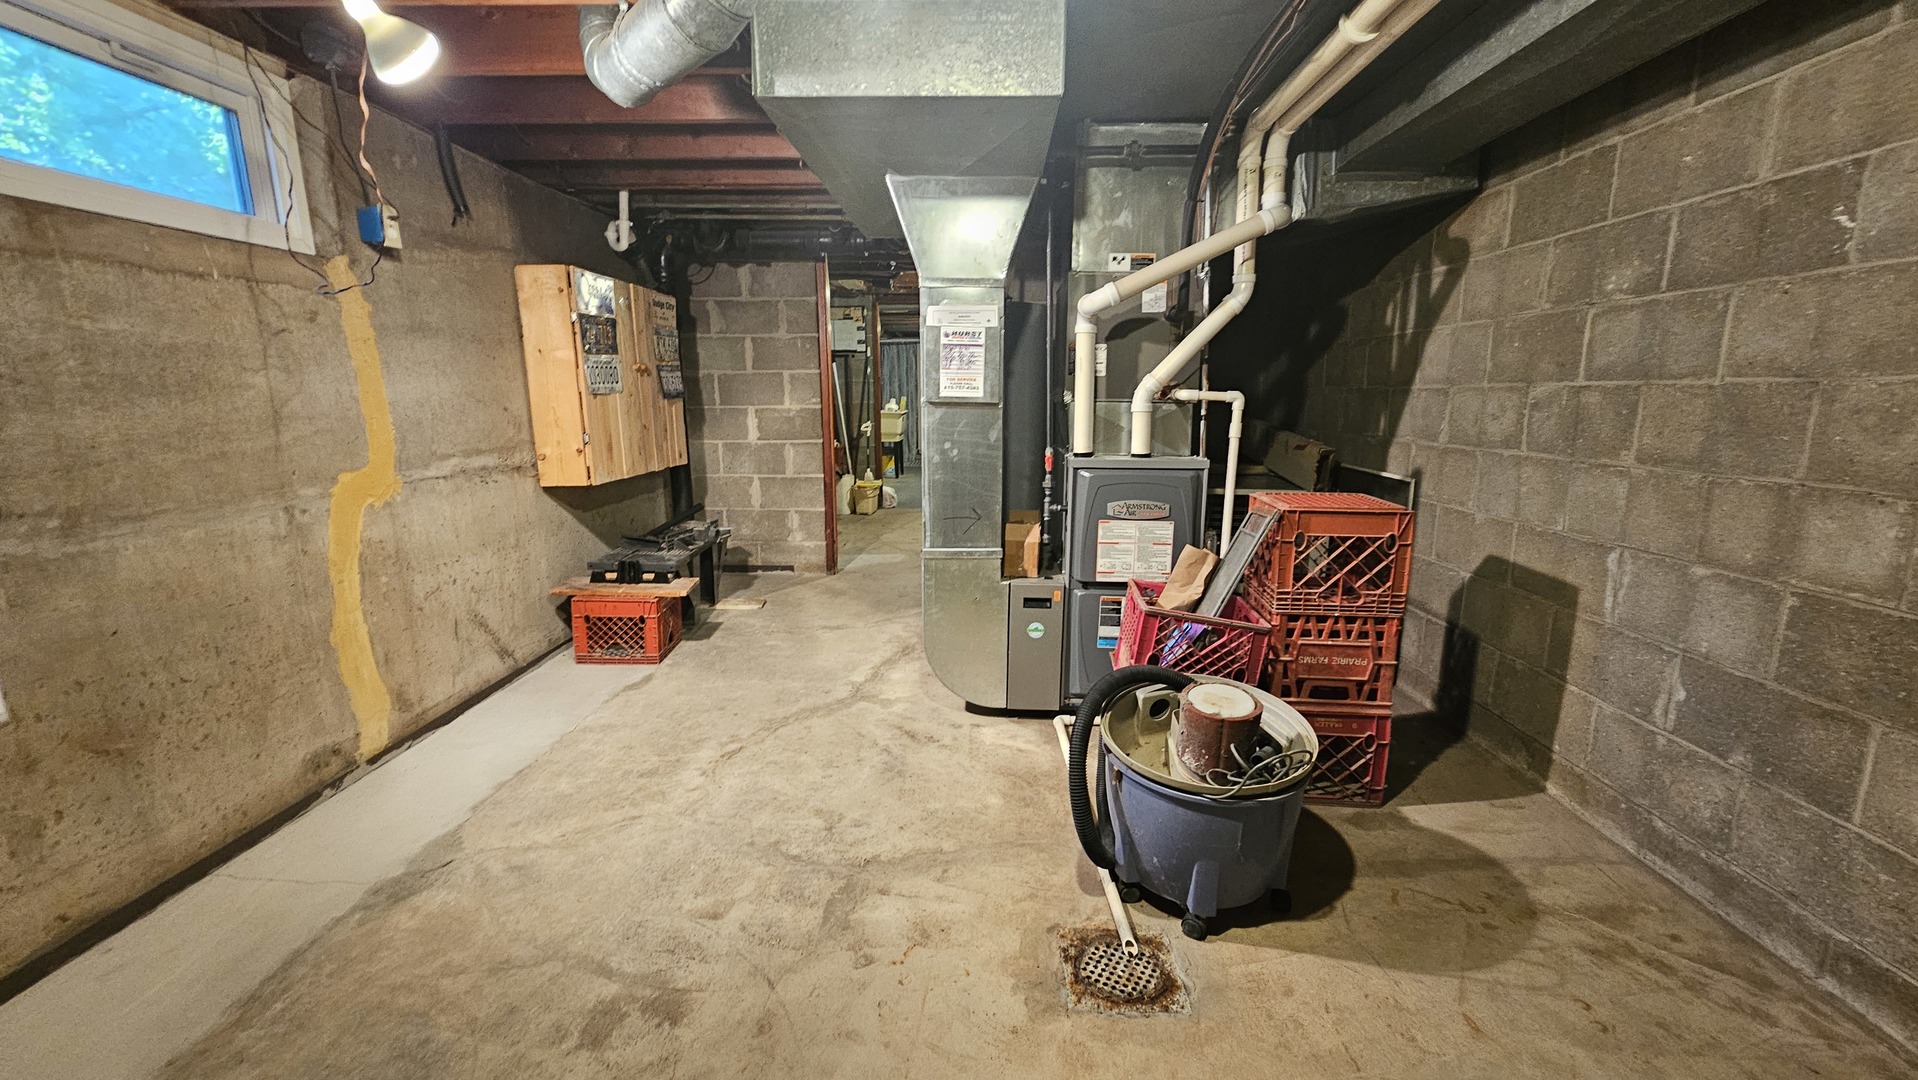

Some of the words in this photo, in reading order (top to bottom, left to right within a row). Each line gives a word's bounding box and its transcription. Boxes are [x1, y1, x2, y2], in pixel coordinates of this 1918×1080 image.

[1122, 502, 1166, 511] ARMSTRONG
[1124, 509, 1137, 517] AIR
[1298, 656, 1329, 664] FARMS
[1331, 657, 1368, 666] PRAIRIE
